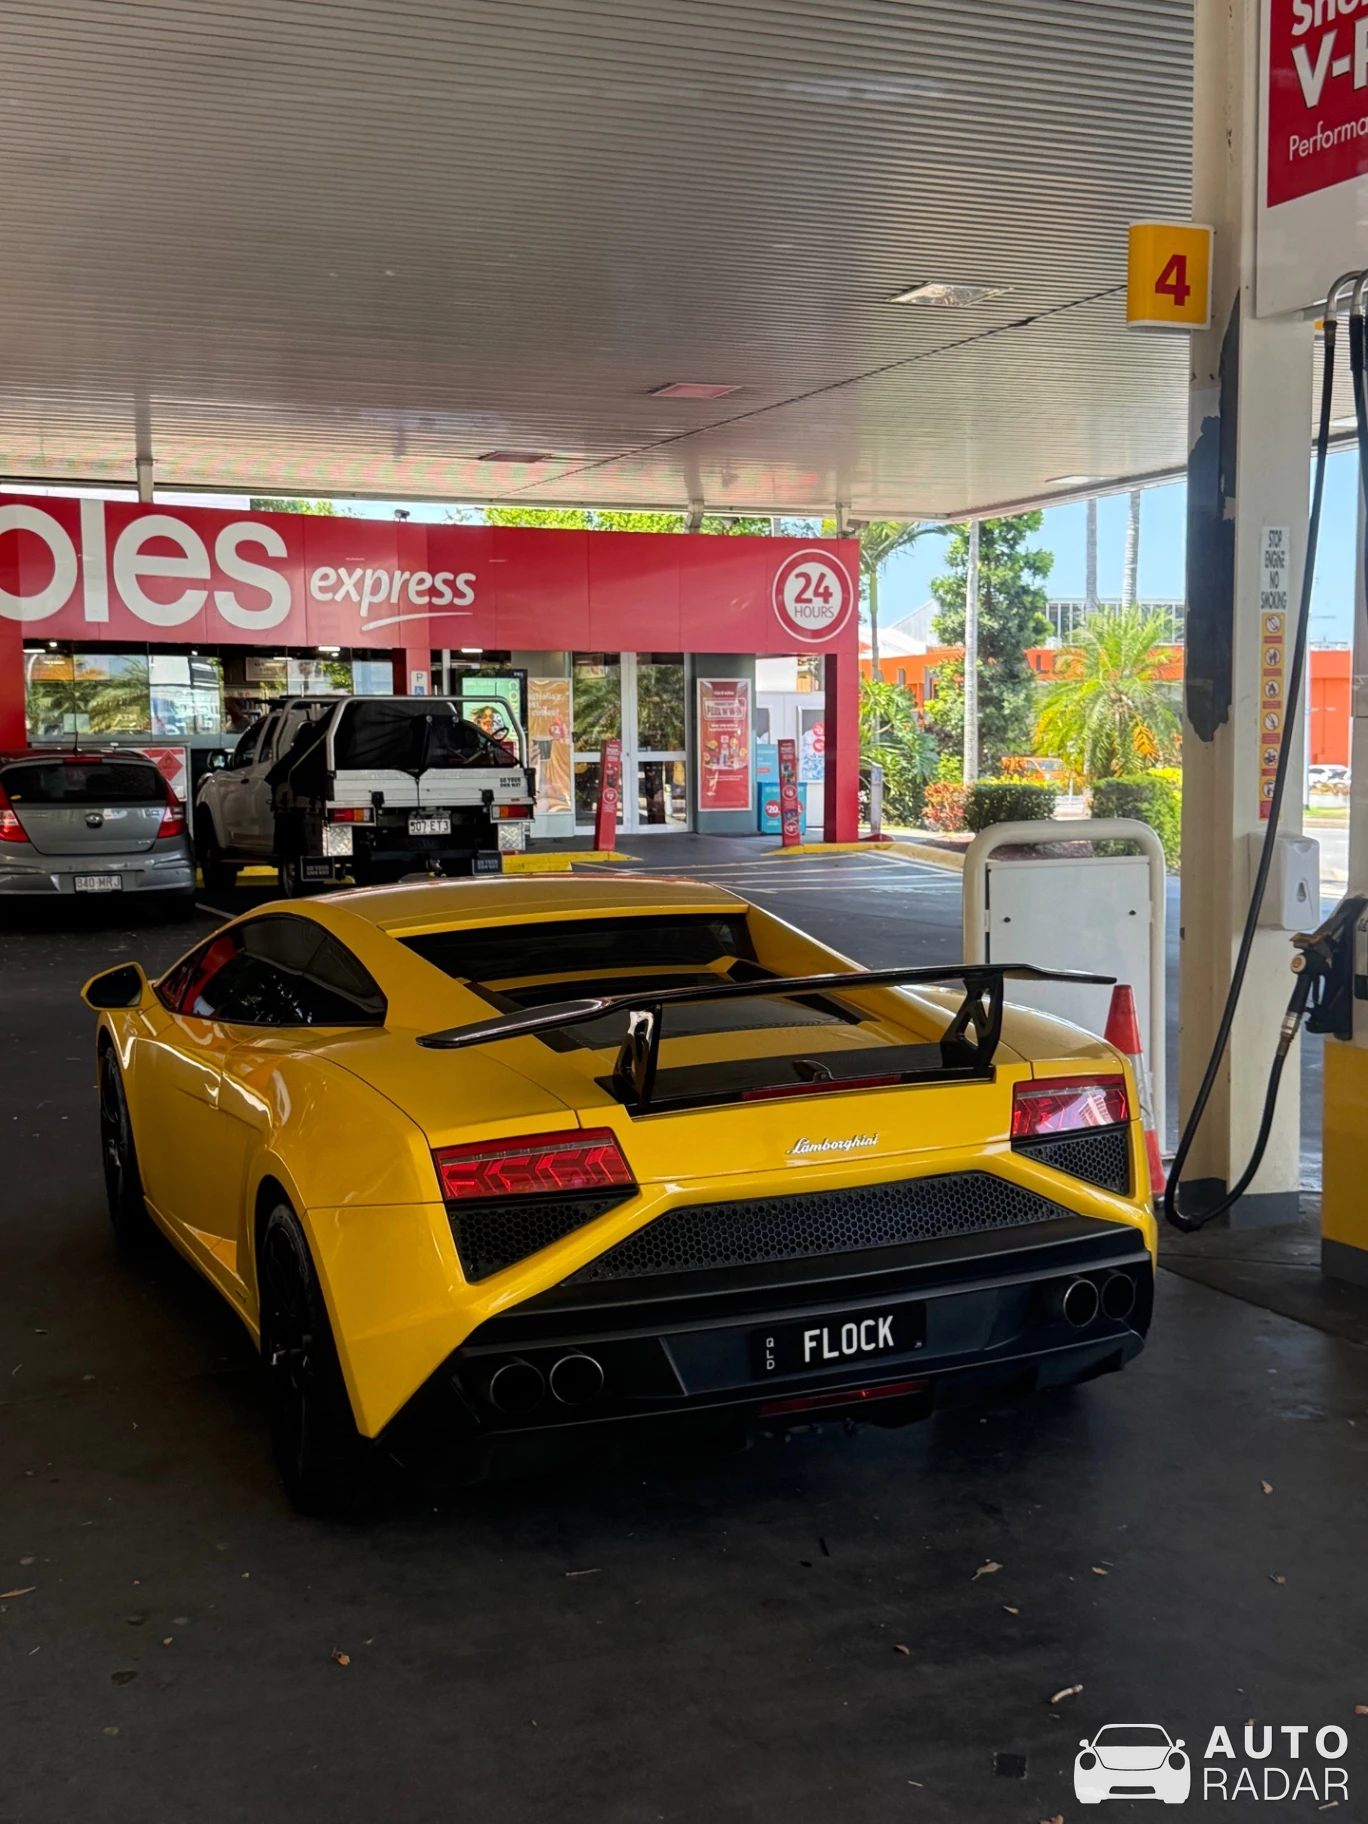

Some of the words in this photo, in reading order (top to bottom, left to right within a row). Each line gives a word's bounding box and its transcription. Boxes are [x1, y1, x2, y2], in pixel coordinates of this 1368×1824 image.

[1155, 254, 1191, 306] 4
[1268, 530, 1283, 548] STOP
[0, 499, 291, 630] oles
[310, 566, 477, 617] express
[1264, 550, 1285, 568] ENGINE
[794, 571, 833, 605] 24
[1269, 571, 1280, 589] NO
[1260, 591, 1287, 609] SMOKING
[794, 605, 835, 619] HOURS
[416, 673, 423, 682] P
[786, 1133, 879, 1155] Lamborghini
[804, 1315, 895, 1362] FLOCK
[766, 1337, 775, 1370] QLD
